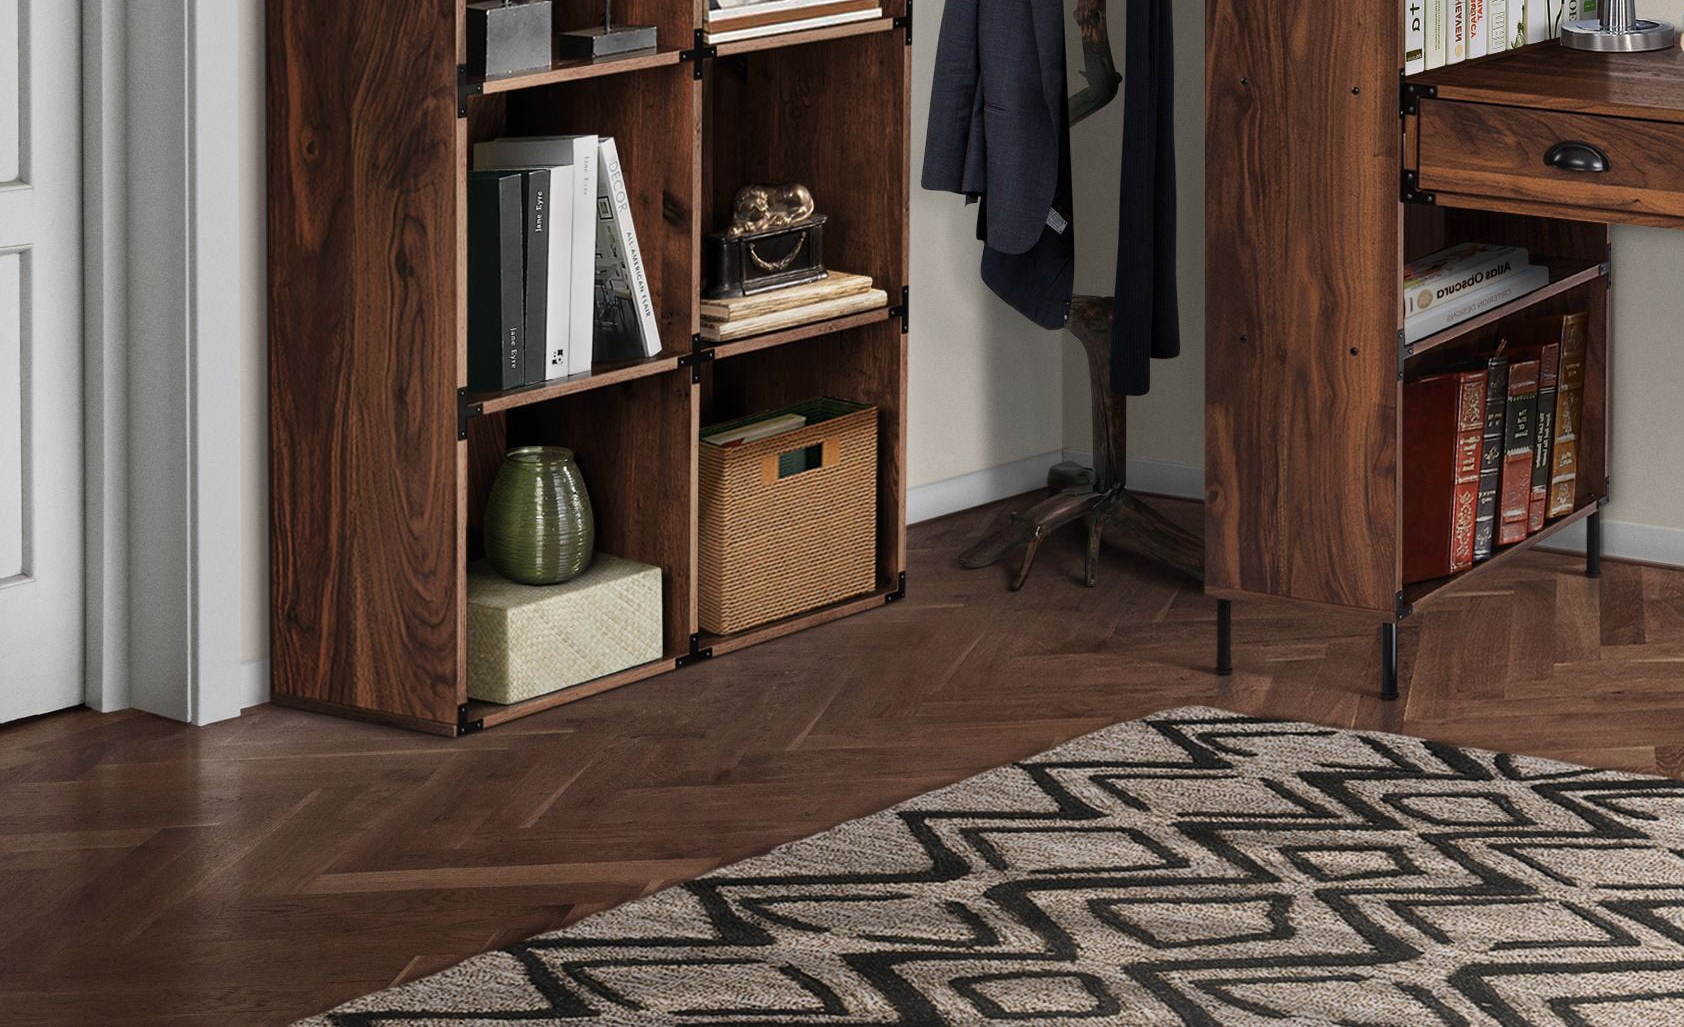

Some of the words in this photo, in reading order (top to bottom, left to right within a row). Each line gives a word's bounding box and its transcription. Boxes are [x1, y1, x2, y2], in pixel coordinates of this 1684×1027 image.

[608, 160, 628, 214] DECOR
[536, 190, 544, 212] Eyre
[535, 212, 543, 233] Jane
[510, 348, 518, 370] Eyre
